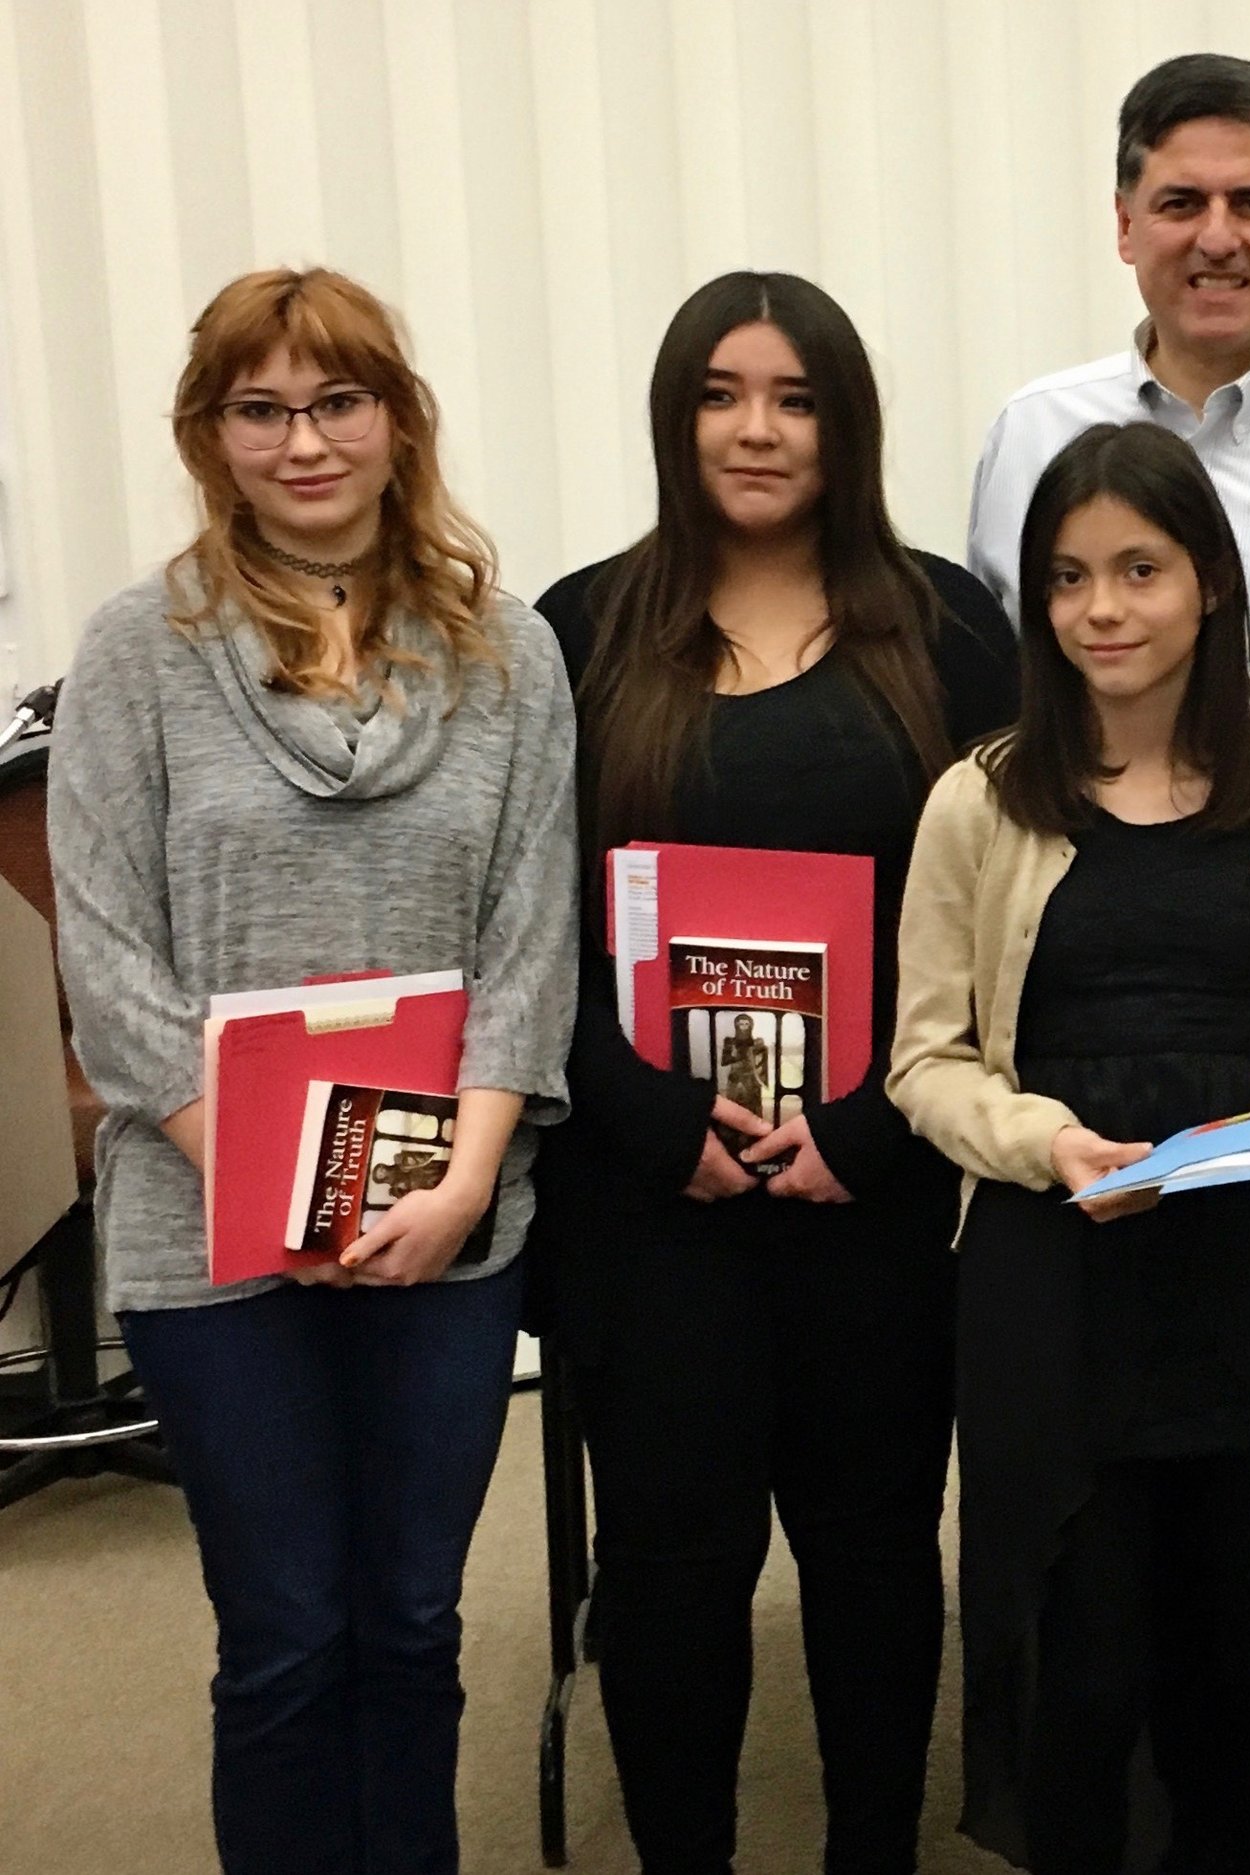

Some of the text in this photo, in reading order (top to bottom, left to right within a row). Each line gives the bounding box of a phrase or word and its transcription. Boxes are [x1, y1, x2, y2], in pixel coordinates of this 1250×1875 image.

[685, 955, 811, 981] The Nature
[702, 978, 793, 1000] of Truth
[314, 1098, 352, 1233] The Nature
[338, 1119, 367, 1216] of Truth
